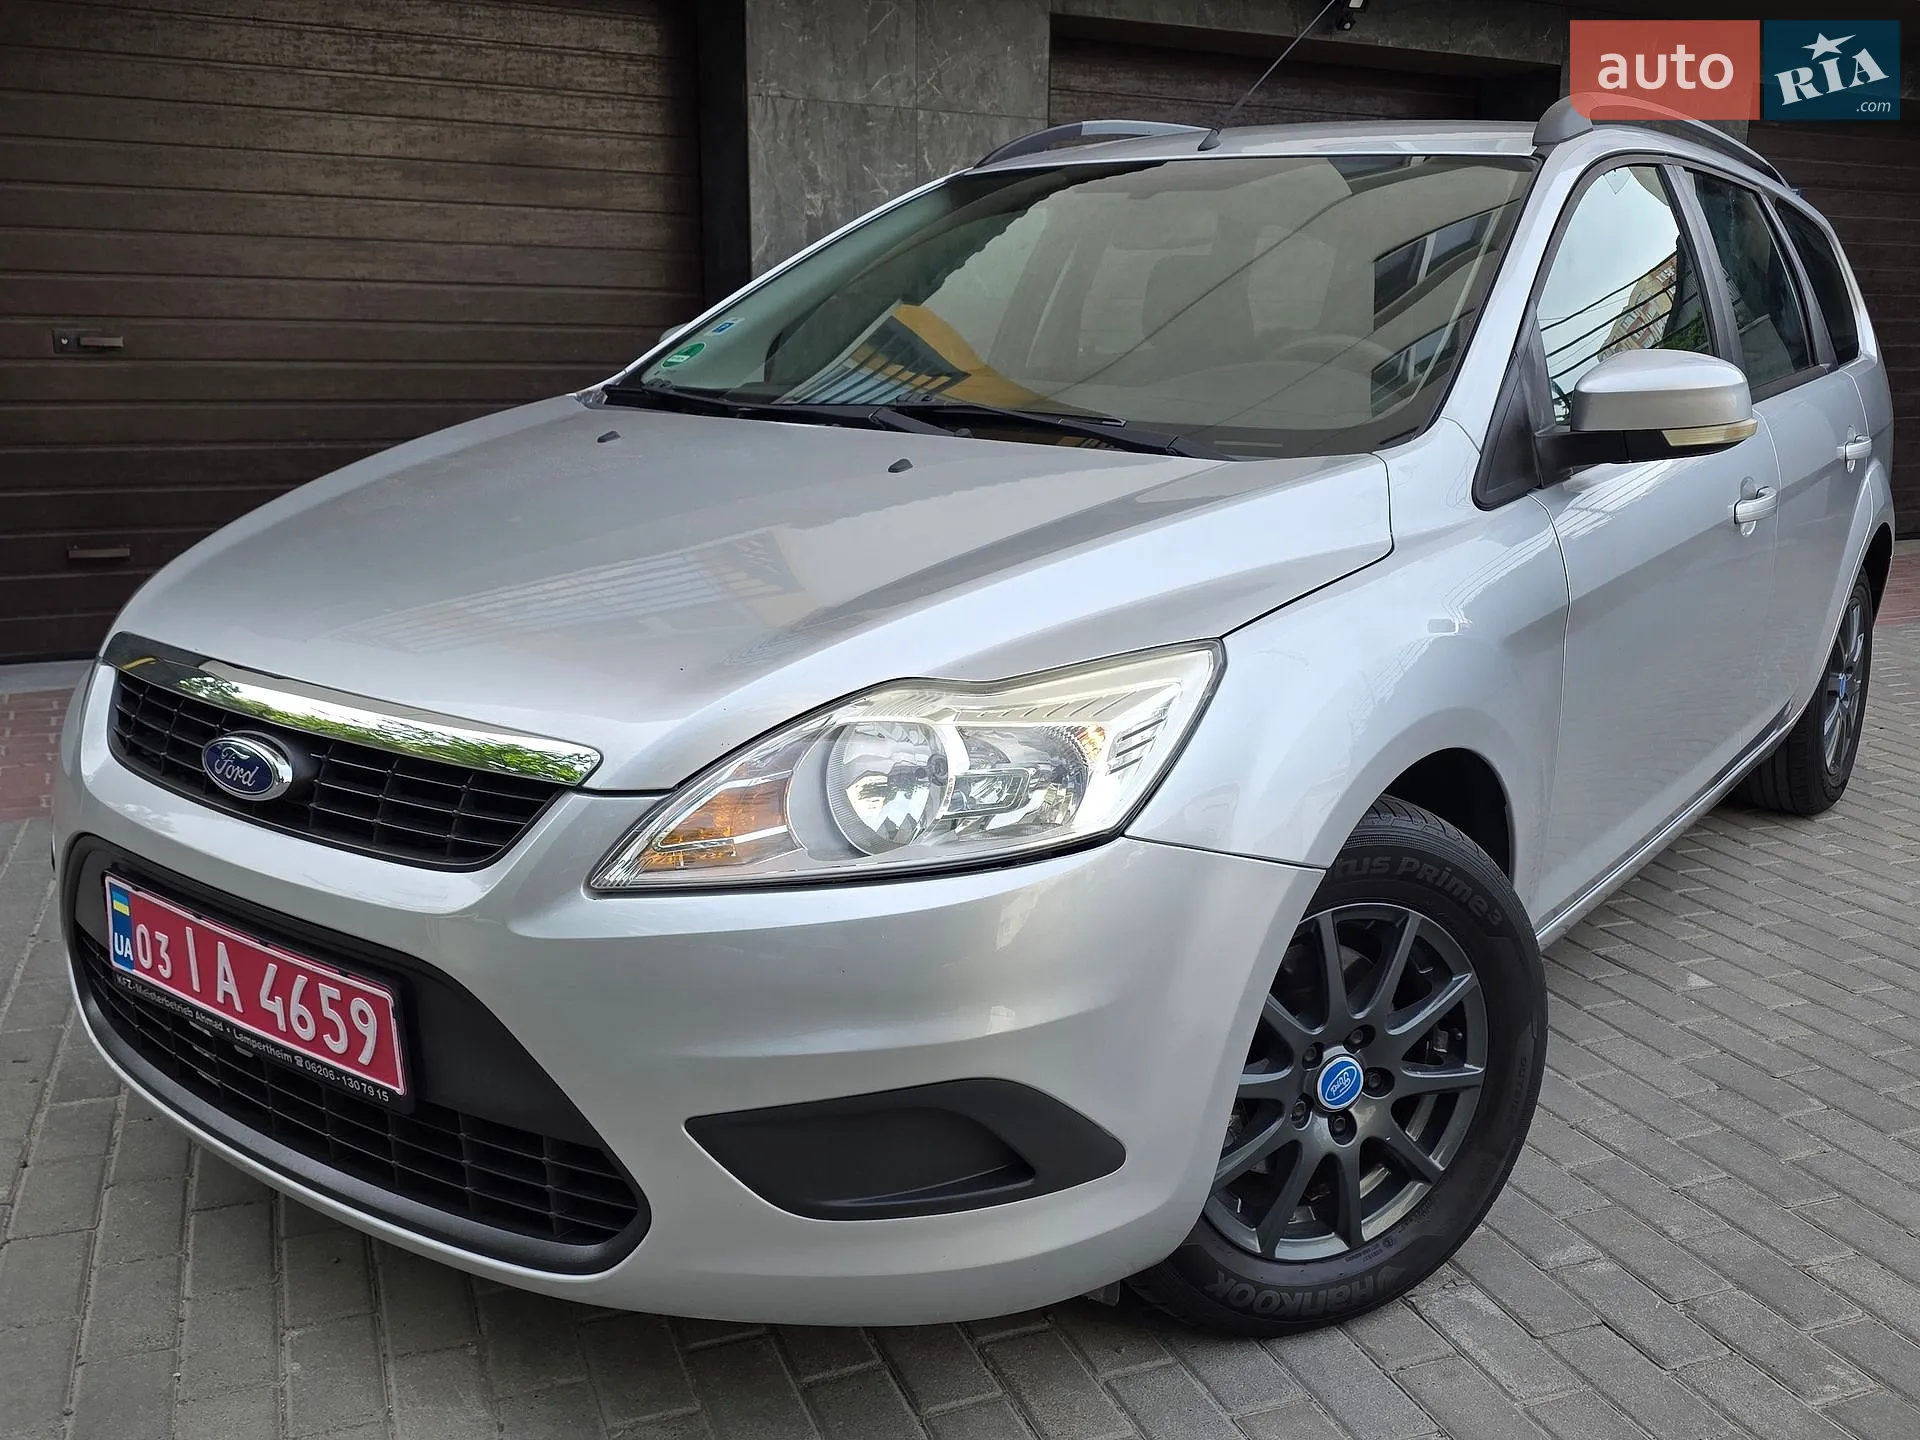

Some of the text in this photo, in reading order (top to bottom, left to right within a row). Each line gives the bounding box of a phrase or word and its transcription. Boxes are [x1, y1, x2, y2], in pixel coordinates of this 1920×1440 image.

[213, 745, 260, 787] Ford
[113, 931, 134, 962] UA
[135, 923, 174, 980] 03
[259, 962, 378, 1067] 4659
[232, 1027, 294, 1063] Lampertheim
